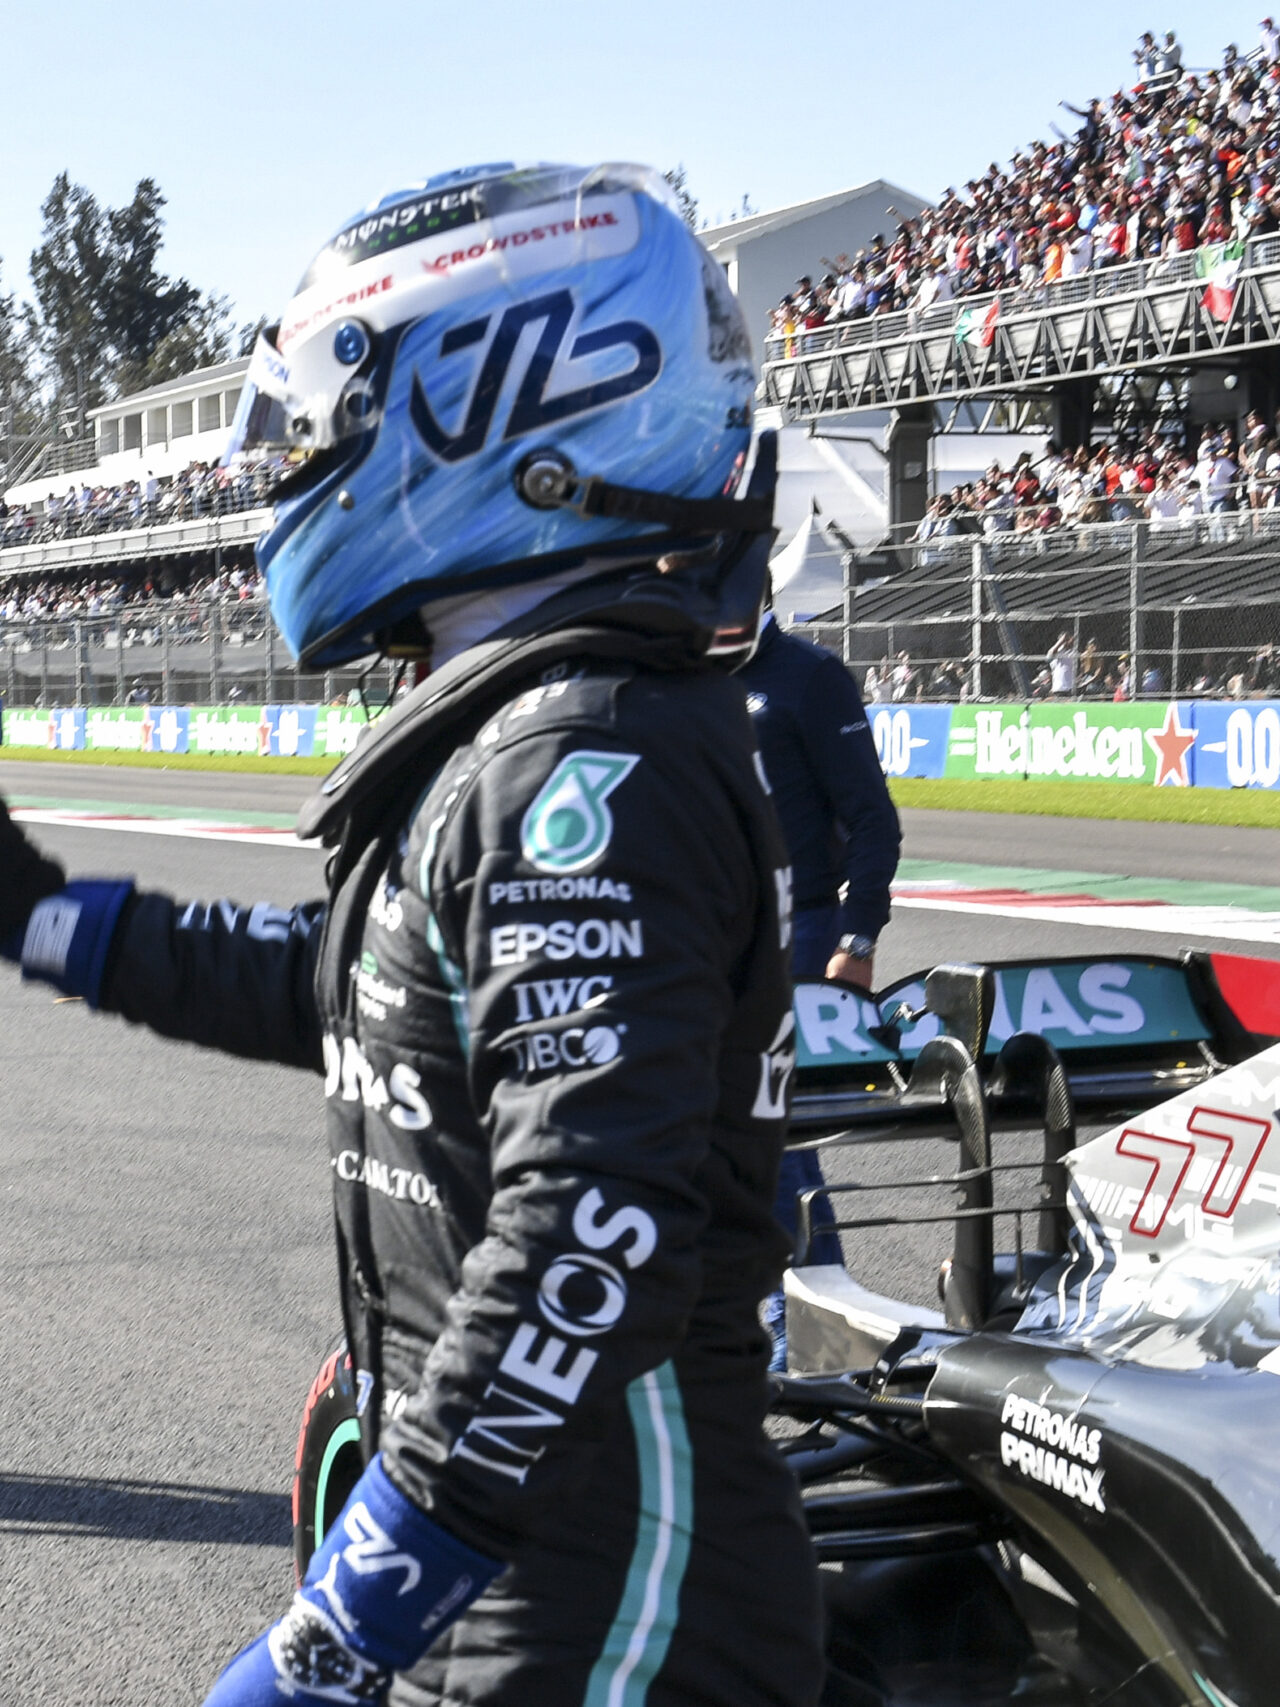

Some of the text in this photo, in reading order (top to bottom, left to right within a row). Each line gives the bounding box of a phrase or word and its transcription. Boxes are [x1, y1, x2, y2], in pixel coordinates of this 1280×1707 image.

[433, 211, 618, 271] CROWDSTRIKE
[974, 709, 1147, 778] Heineken
[489, 876, 632, 904] PETRONAS
[489, 919, 643, 967] EPSON
[513, 974, 612, 1023] IWC
[1116, 1105, 1272, 1238] 77
[451, 1187, 658, 1484] INEOS
[1000, 1393, 1103, 1464] PETRONAS
[999, 1432, 1107, 1513] PRIMAX
